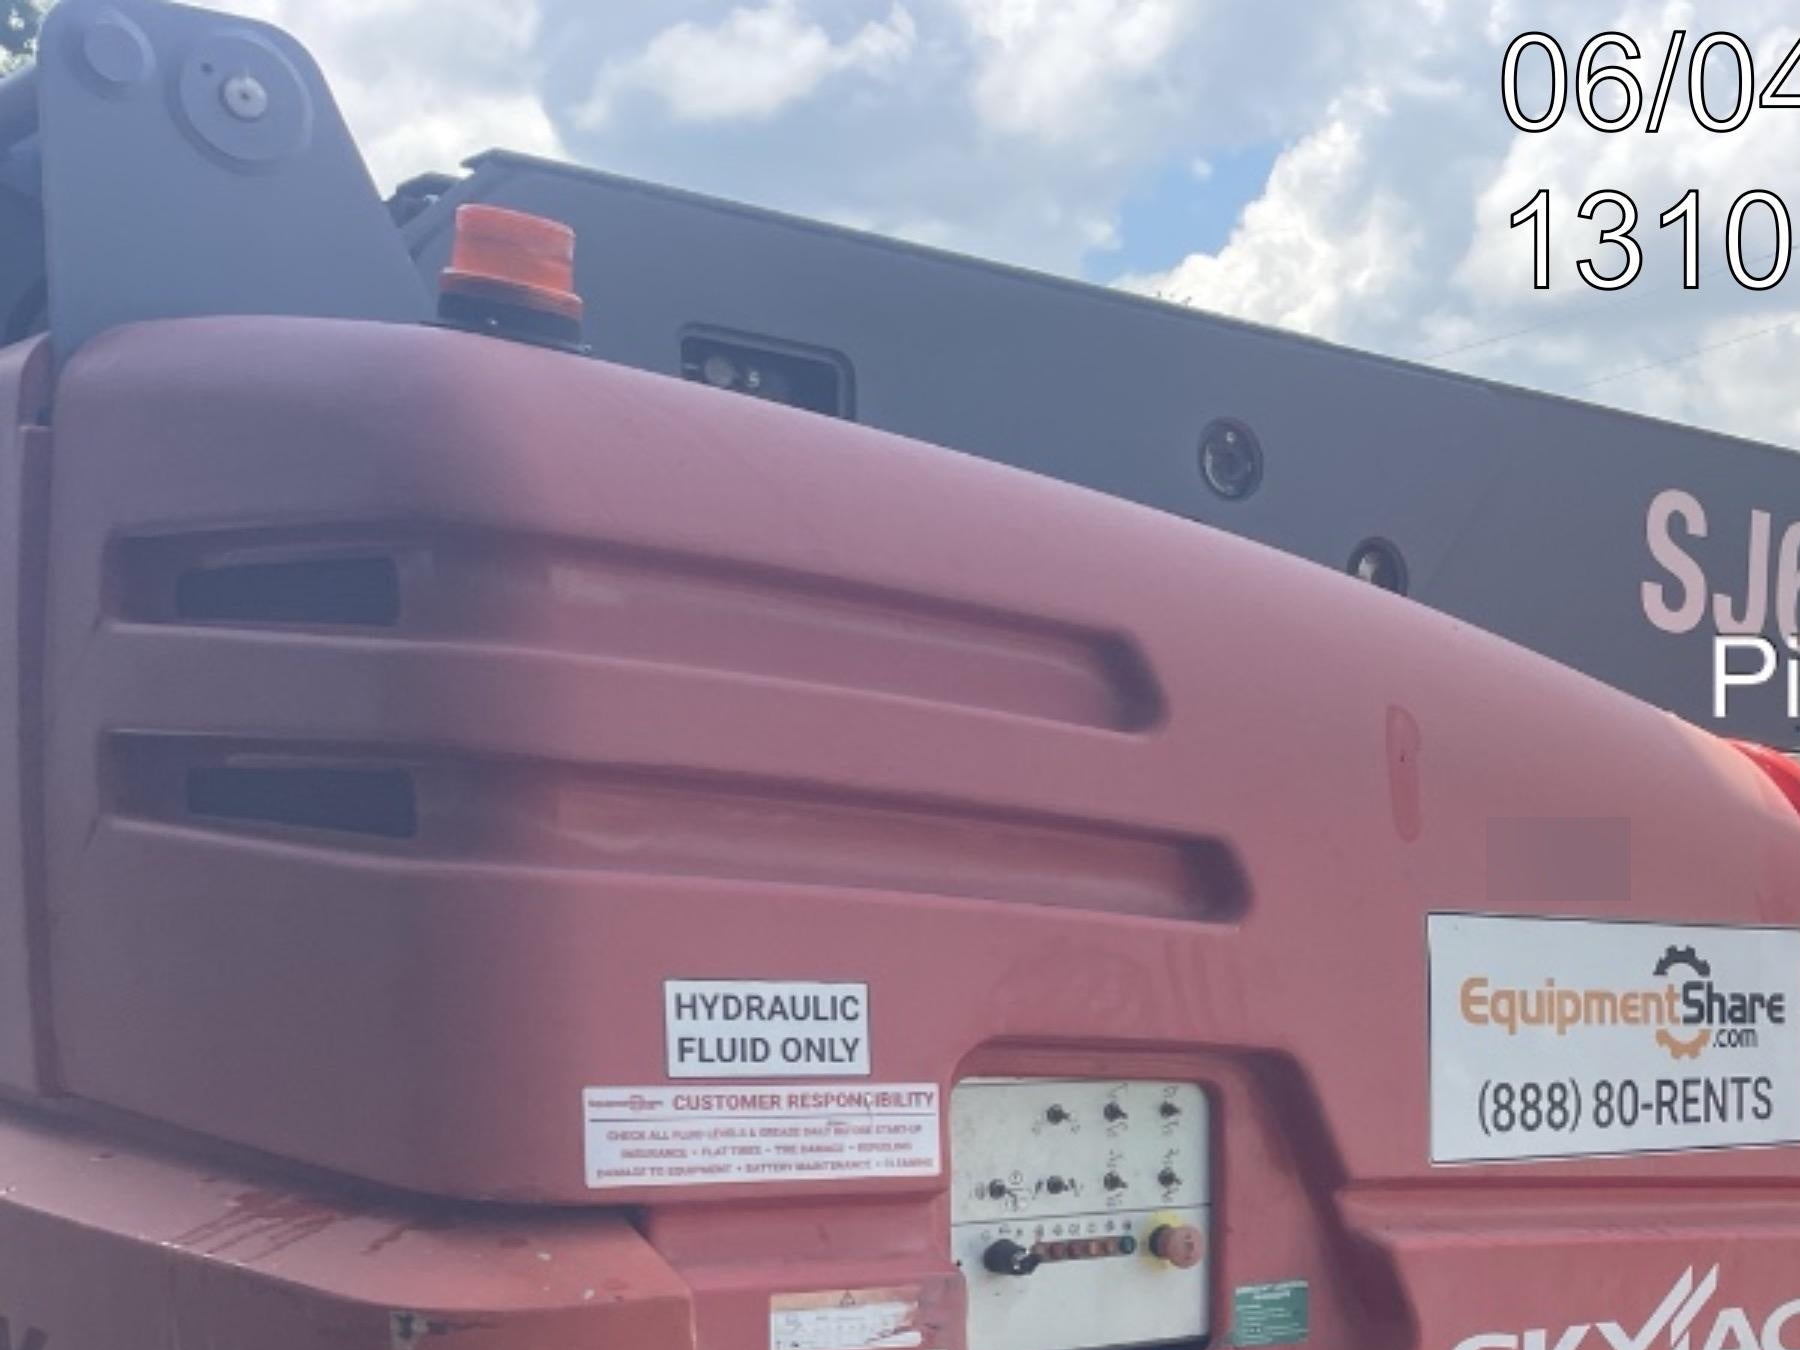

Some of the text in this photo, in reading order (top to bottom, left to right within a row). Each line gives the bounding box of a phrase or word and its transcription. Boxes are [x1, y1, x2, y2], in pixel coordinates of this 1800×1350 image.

[673, 992, 861, 1023] HYDRAULIC
[1460, 977, 1786, 1036] EquipmentShare
[677, 1035, 861, 1065] FLUID ONLY
[1712, 1028, 1759, 1049] .com
[673, 1093, 782, 1112] CUSTOMER
[1478, 1076, 1773, 1136] (888) 80-RENTS
